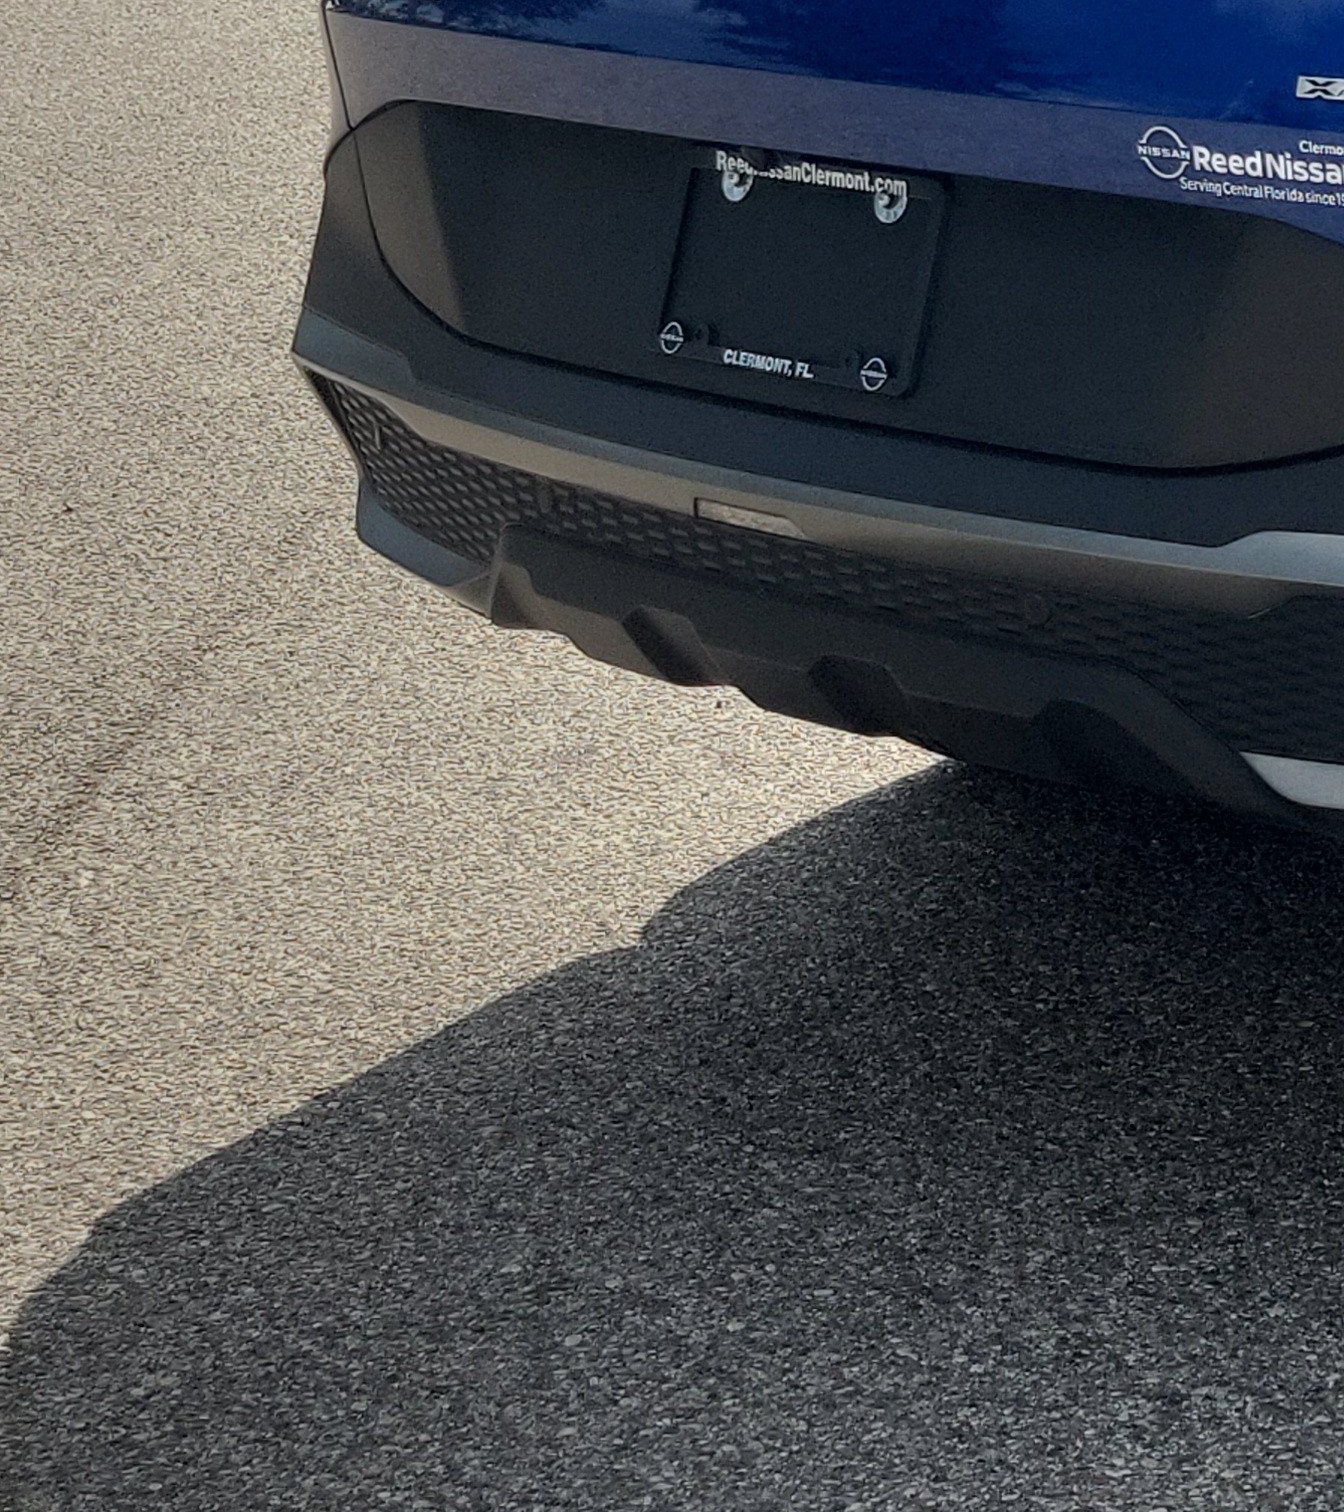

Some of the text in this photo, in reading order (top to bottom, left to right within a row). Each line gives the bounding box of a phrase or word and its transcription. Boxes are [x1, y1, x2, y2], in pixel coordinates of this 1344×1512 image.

[1138, 144, 1190, 160] NISSAN
[715, 150, 907, 197] ReessanClermont.com
[1179, 176, 1222, 197] Serving
[1223, 181, 1263, 198] Central
[1263, 185, 1304, 202] Florida
[1305, 190, 1336, 205] since
[723, 348, 814, 379] CLERMONT, FL
